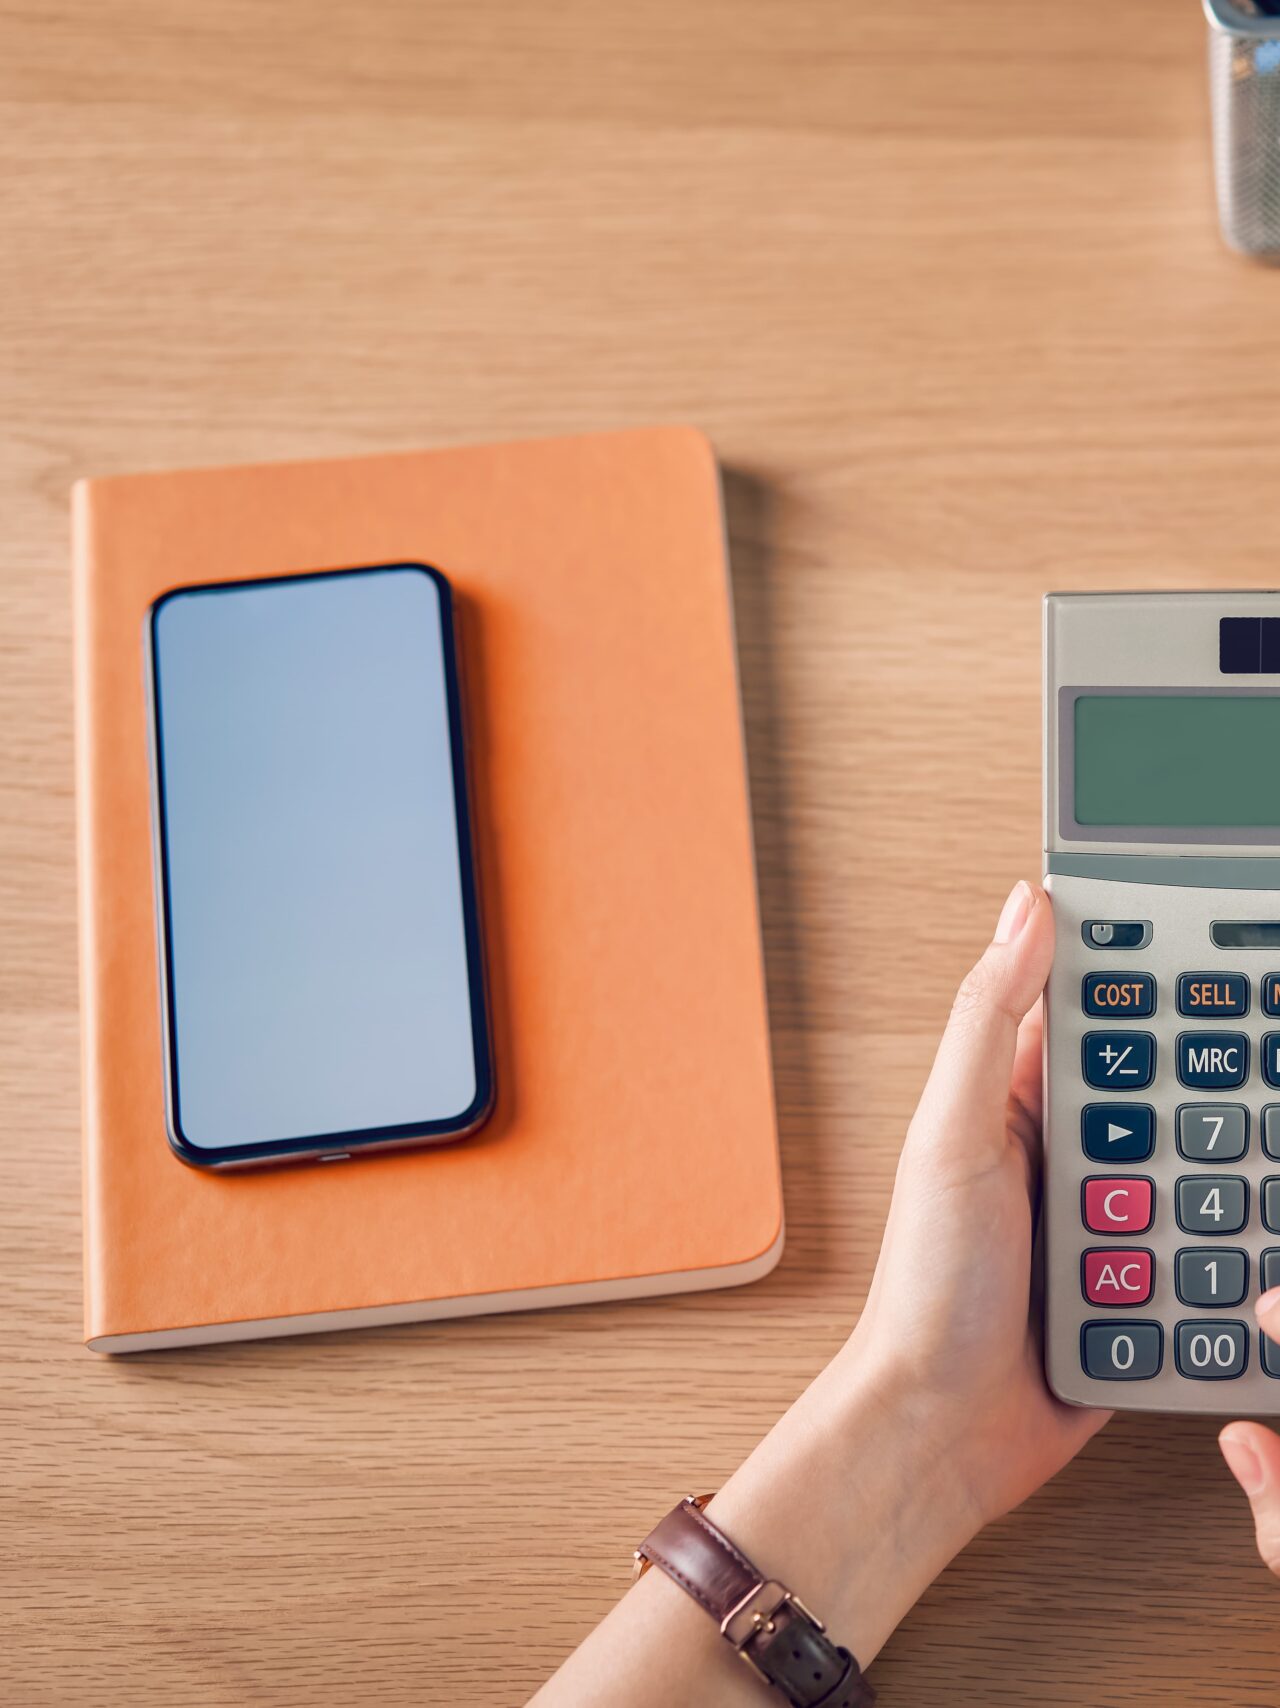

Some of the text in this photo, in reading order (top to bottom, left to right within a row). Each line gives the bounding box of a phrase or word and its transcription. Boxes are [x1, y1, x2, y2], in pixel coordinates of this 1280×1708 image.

[1094, 983, 1144, 1006] COST
[1190, 983, 1236, 1006] SELL
[1188, 1047, 1238, 1073] MRC
[1202, 1116, 1224, 1151] 7
[1103, 1189, 1129, 1222] C
[1199, 1188, 1224, 1222] 4
[1095, 1263, 1141, 1291] AC
[1204, 1261, 1217, 1295] 1
[1111, 1335, 1135, 1370] 0
[1189, 1334, 1236, 1367] 00
